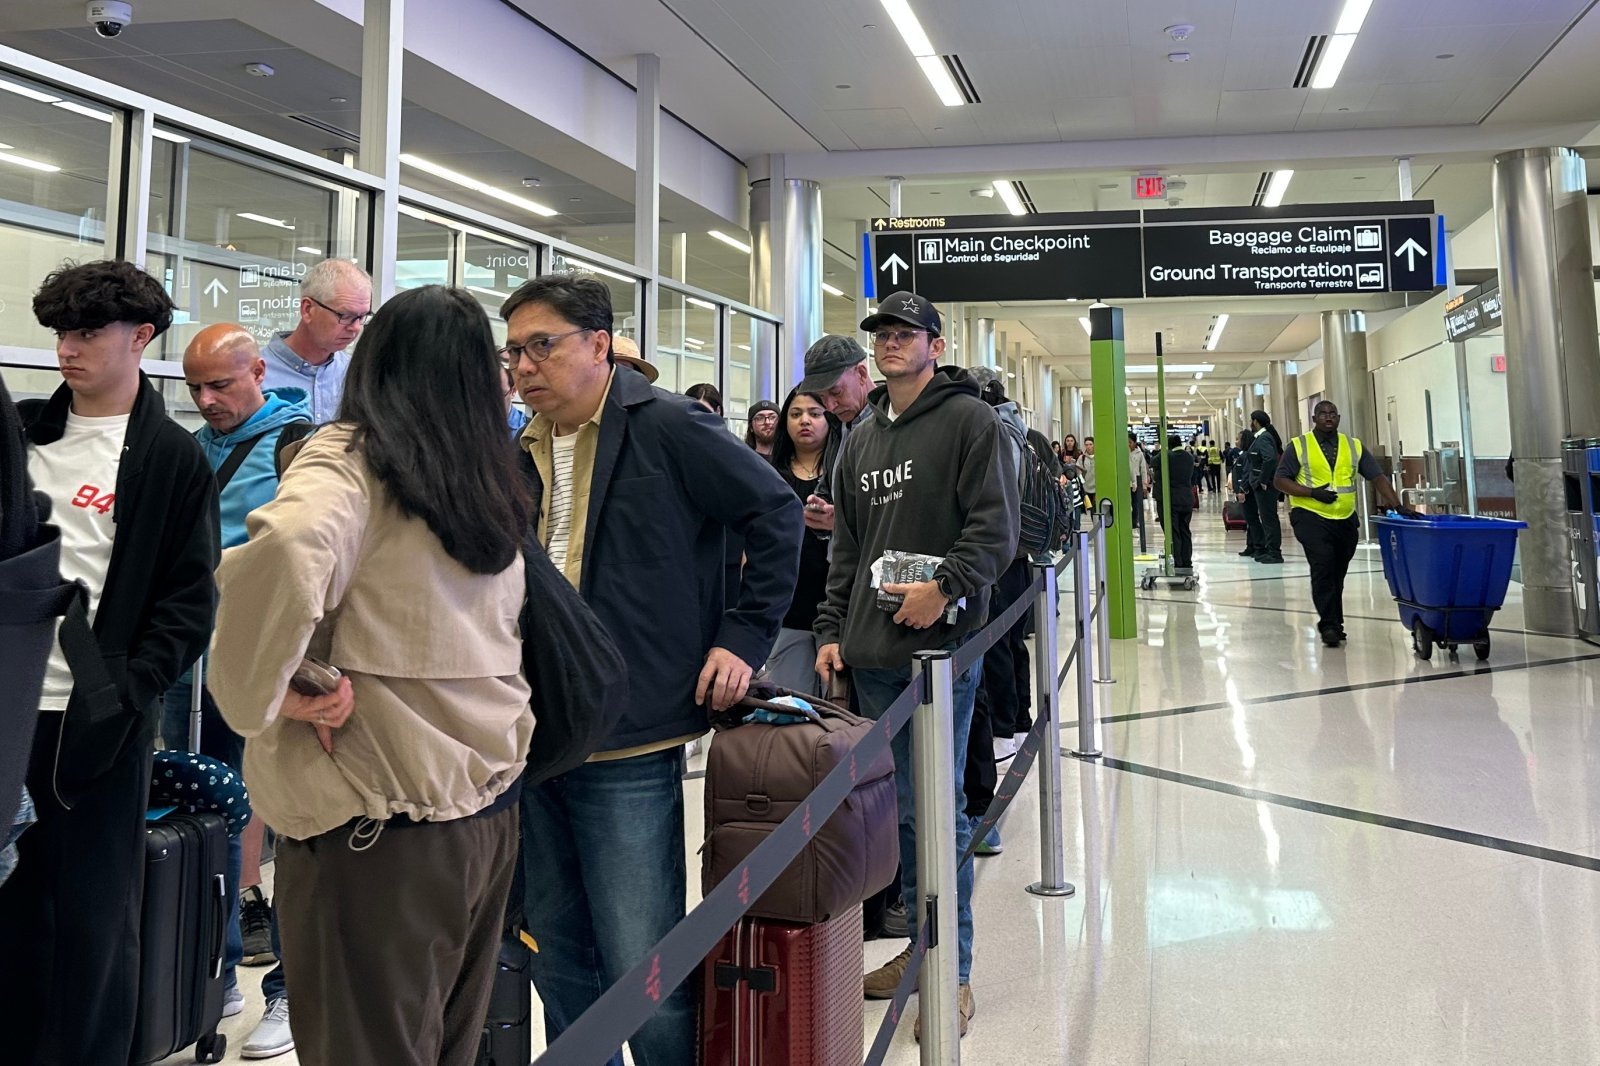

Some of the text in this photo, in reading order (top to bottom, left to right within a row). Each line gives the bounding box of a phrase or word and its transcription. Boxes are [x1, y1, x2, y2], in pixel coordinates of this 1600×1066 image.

[1136, 176, 1163, 198] EXIT
[889, 217, 946, 229] Restrooms
[945, 234, 1091, 252] Main Checkpoint
[1209, 226, 1351, 246] Baggage Claim
[945, 252, 1040, 264] Control de Seguridad
[1251, 243, 1352, 255] Reclamo de Equipaje
[1150, 261, 1354, 281] Ground Transportation
[1255, 279, 1354, 290] Transporte Terrestre
[860, 459, 913, 492] STONE
[71, 484, 117, 515] 94
